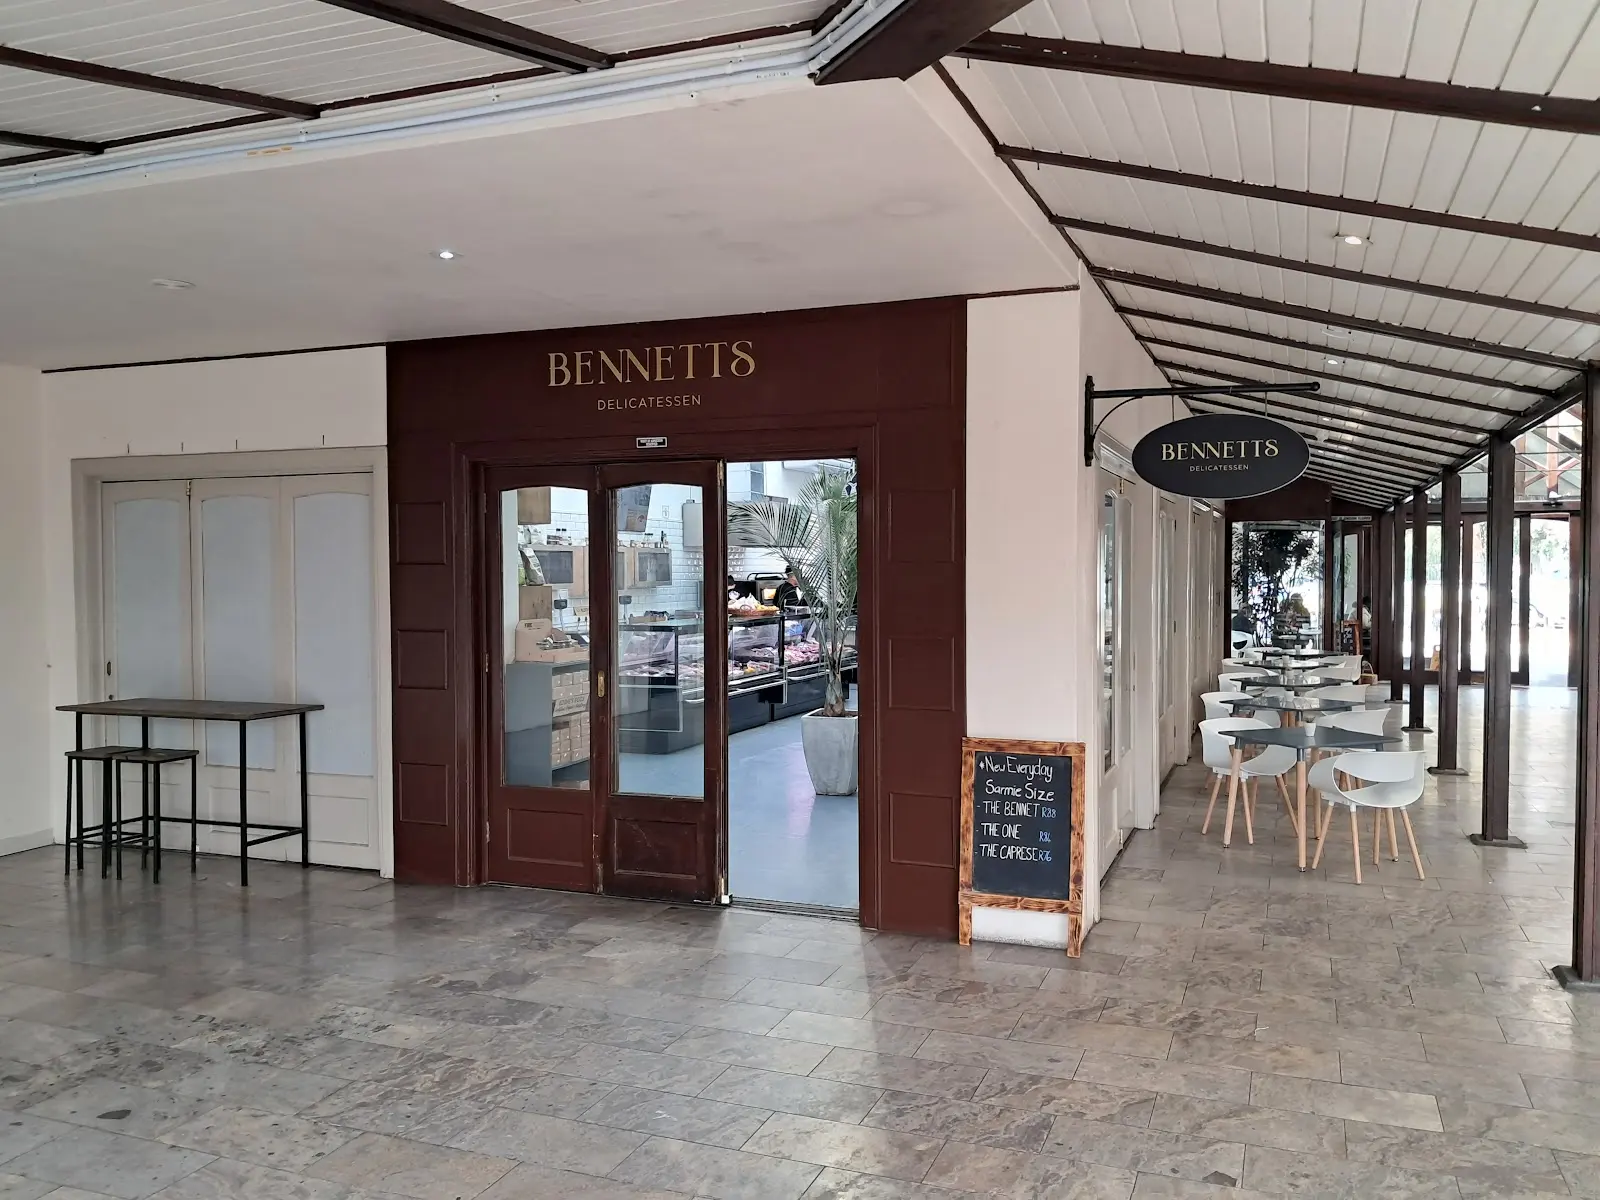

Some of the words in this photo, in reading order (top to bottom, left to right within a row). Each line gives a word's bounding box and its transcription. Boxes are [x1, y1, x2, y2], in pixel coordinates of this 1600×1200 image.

[548, 340, 756, 387] BENNETTS
[597, 394, 702, 411] DELICATESSEN
[1161, 439, 1279, 461] BENNETTS
[1189, 464, 1249, 472] DELICATESSEN
[984, 755, 1006, 773] New
[1006, 755, 1053, 783] Everyday
[985, 779, 1022, 798] Sarmie
[1024, 782, 1055, 802] Size
[982, 800, 1001, 815] THE
[1004, 801, 1041, 818] BENNET
[980, 823, 1001, 837] THE
[1001, 824, 1022, 840] ONE
[979, 843, 1000, 858] THE
[1000, 845, 1039, 862] CAPRESE
